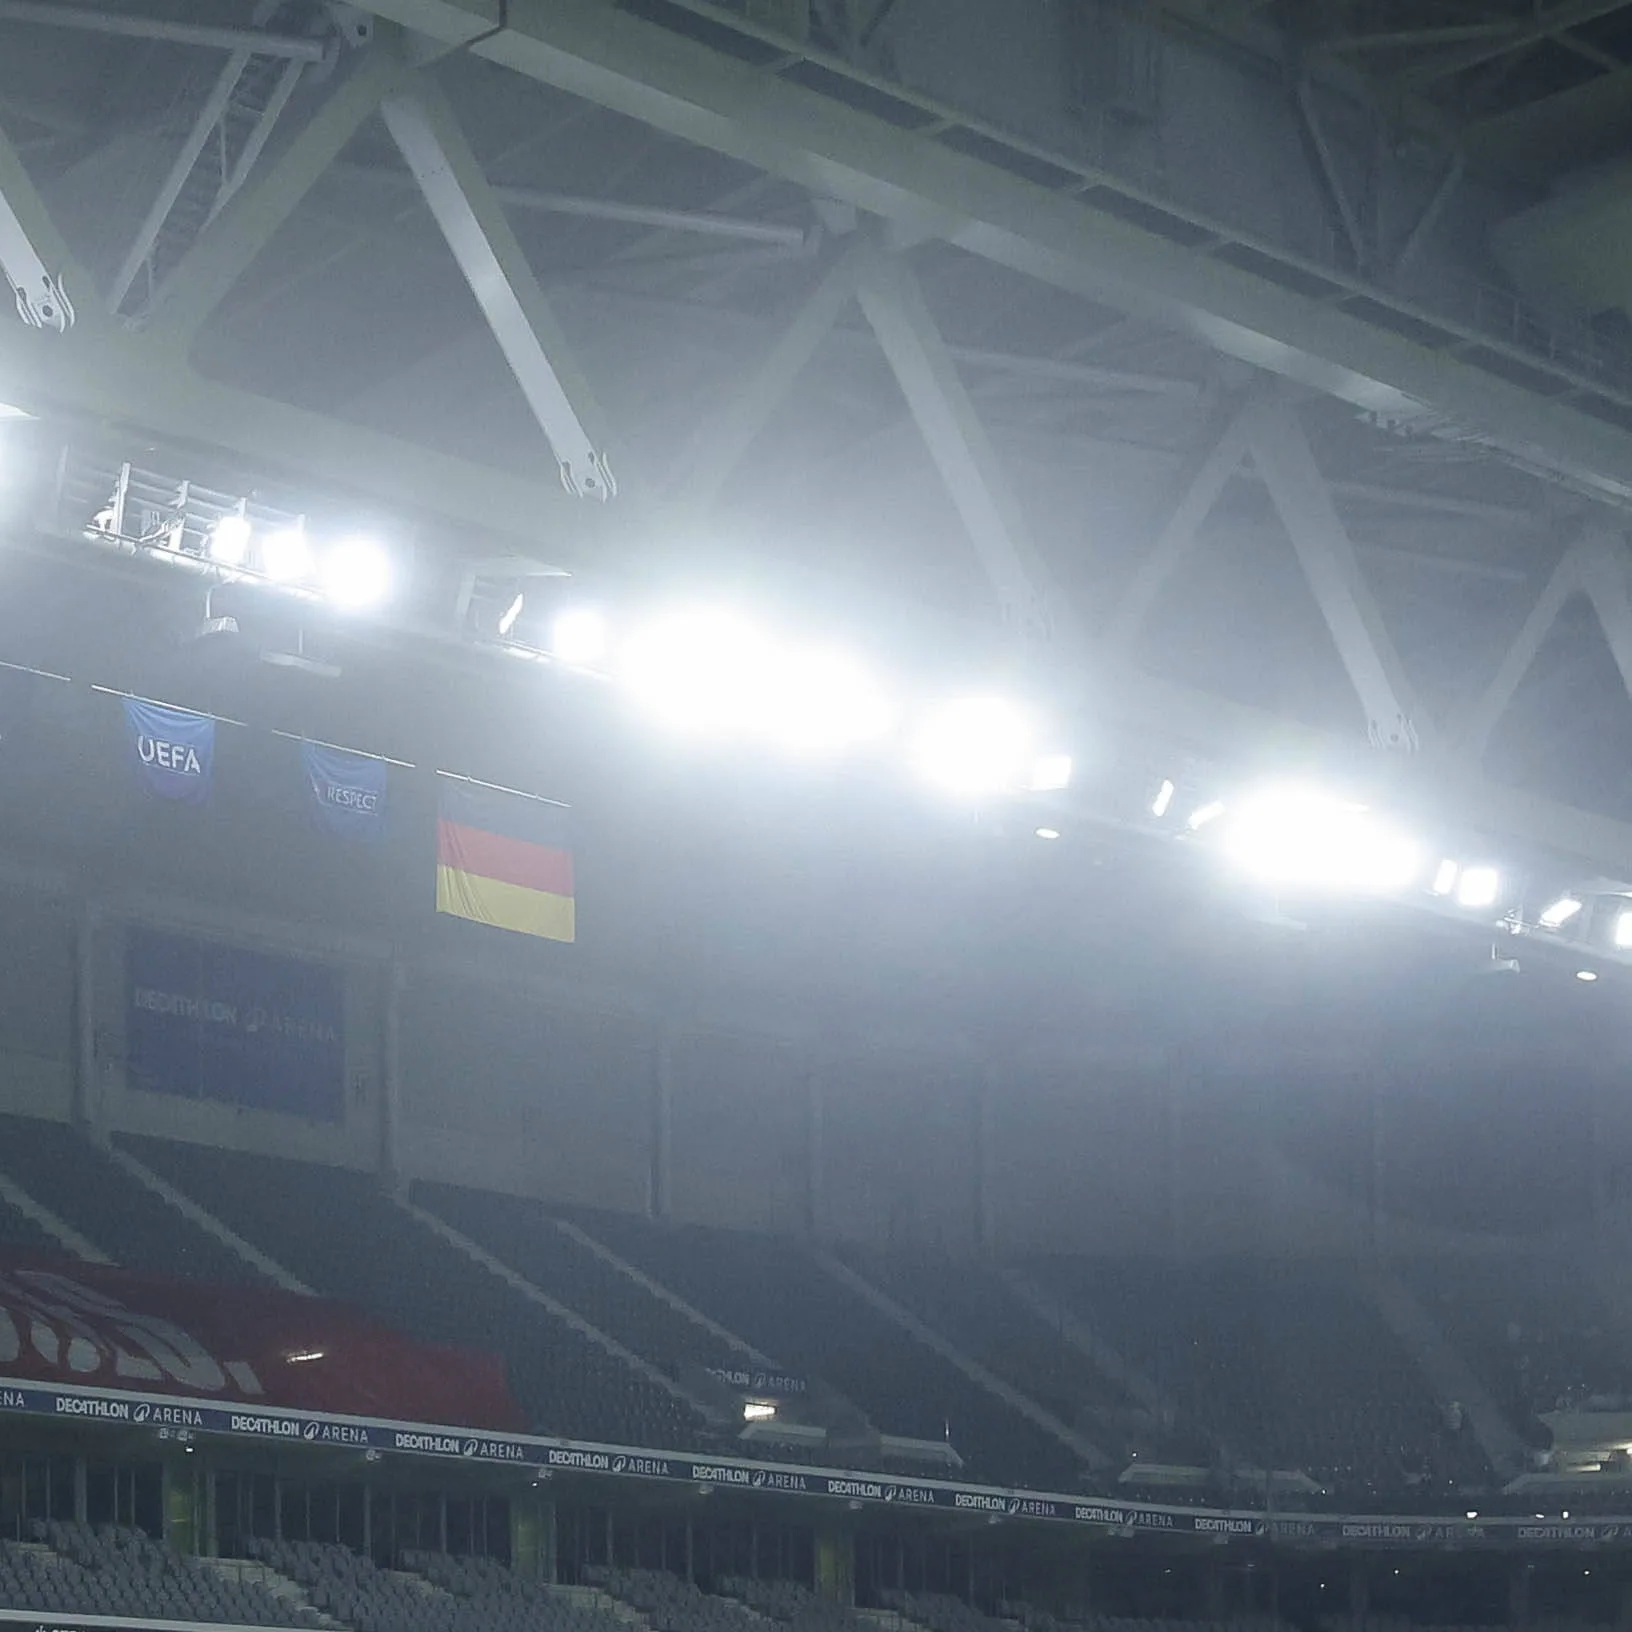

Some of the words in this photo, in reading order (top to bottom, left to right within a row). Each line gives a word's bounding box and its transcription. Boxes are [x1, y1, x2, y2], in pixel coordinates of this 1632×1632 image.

[137, 735, 201, 774] UEFA
[327, 786, 377, 812] RESPECT
[56, 1397, 129, 1420] DECATHLON
[154, 1405, 203, 1425] ARENA
[231, 1415, 300, 1436] DECATHLON
[322, 1424, 369, 1442] ARENA
[395, 1433, 460, 1453] DECATHLON
[480, 1443, 524, 1460] ARENA
[548, 1450, 609, 1470] DECATHLON
[628, 1458, 669, 1475] ARENA
[692, 1464, 750, 1484] DECATHLON
[767, 1473, 807, 1490] ARENA
[827, 1480, 882, 1498] DECATHLON
[898, 1487, 935, 1503] ARENA
[955, 1493, 1006, 1511] DECATHLON
[1021, 1500, 1056, 1516] ARENA
[1075, 1506, 1123, 1524] DECATHLON
[1139, 1511, 1174, 1528] ARENA
[1194, 1517, 1252, 1533] DECATHLON
